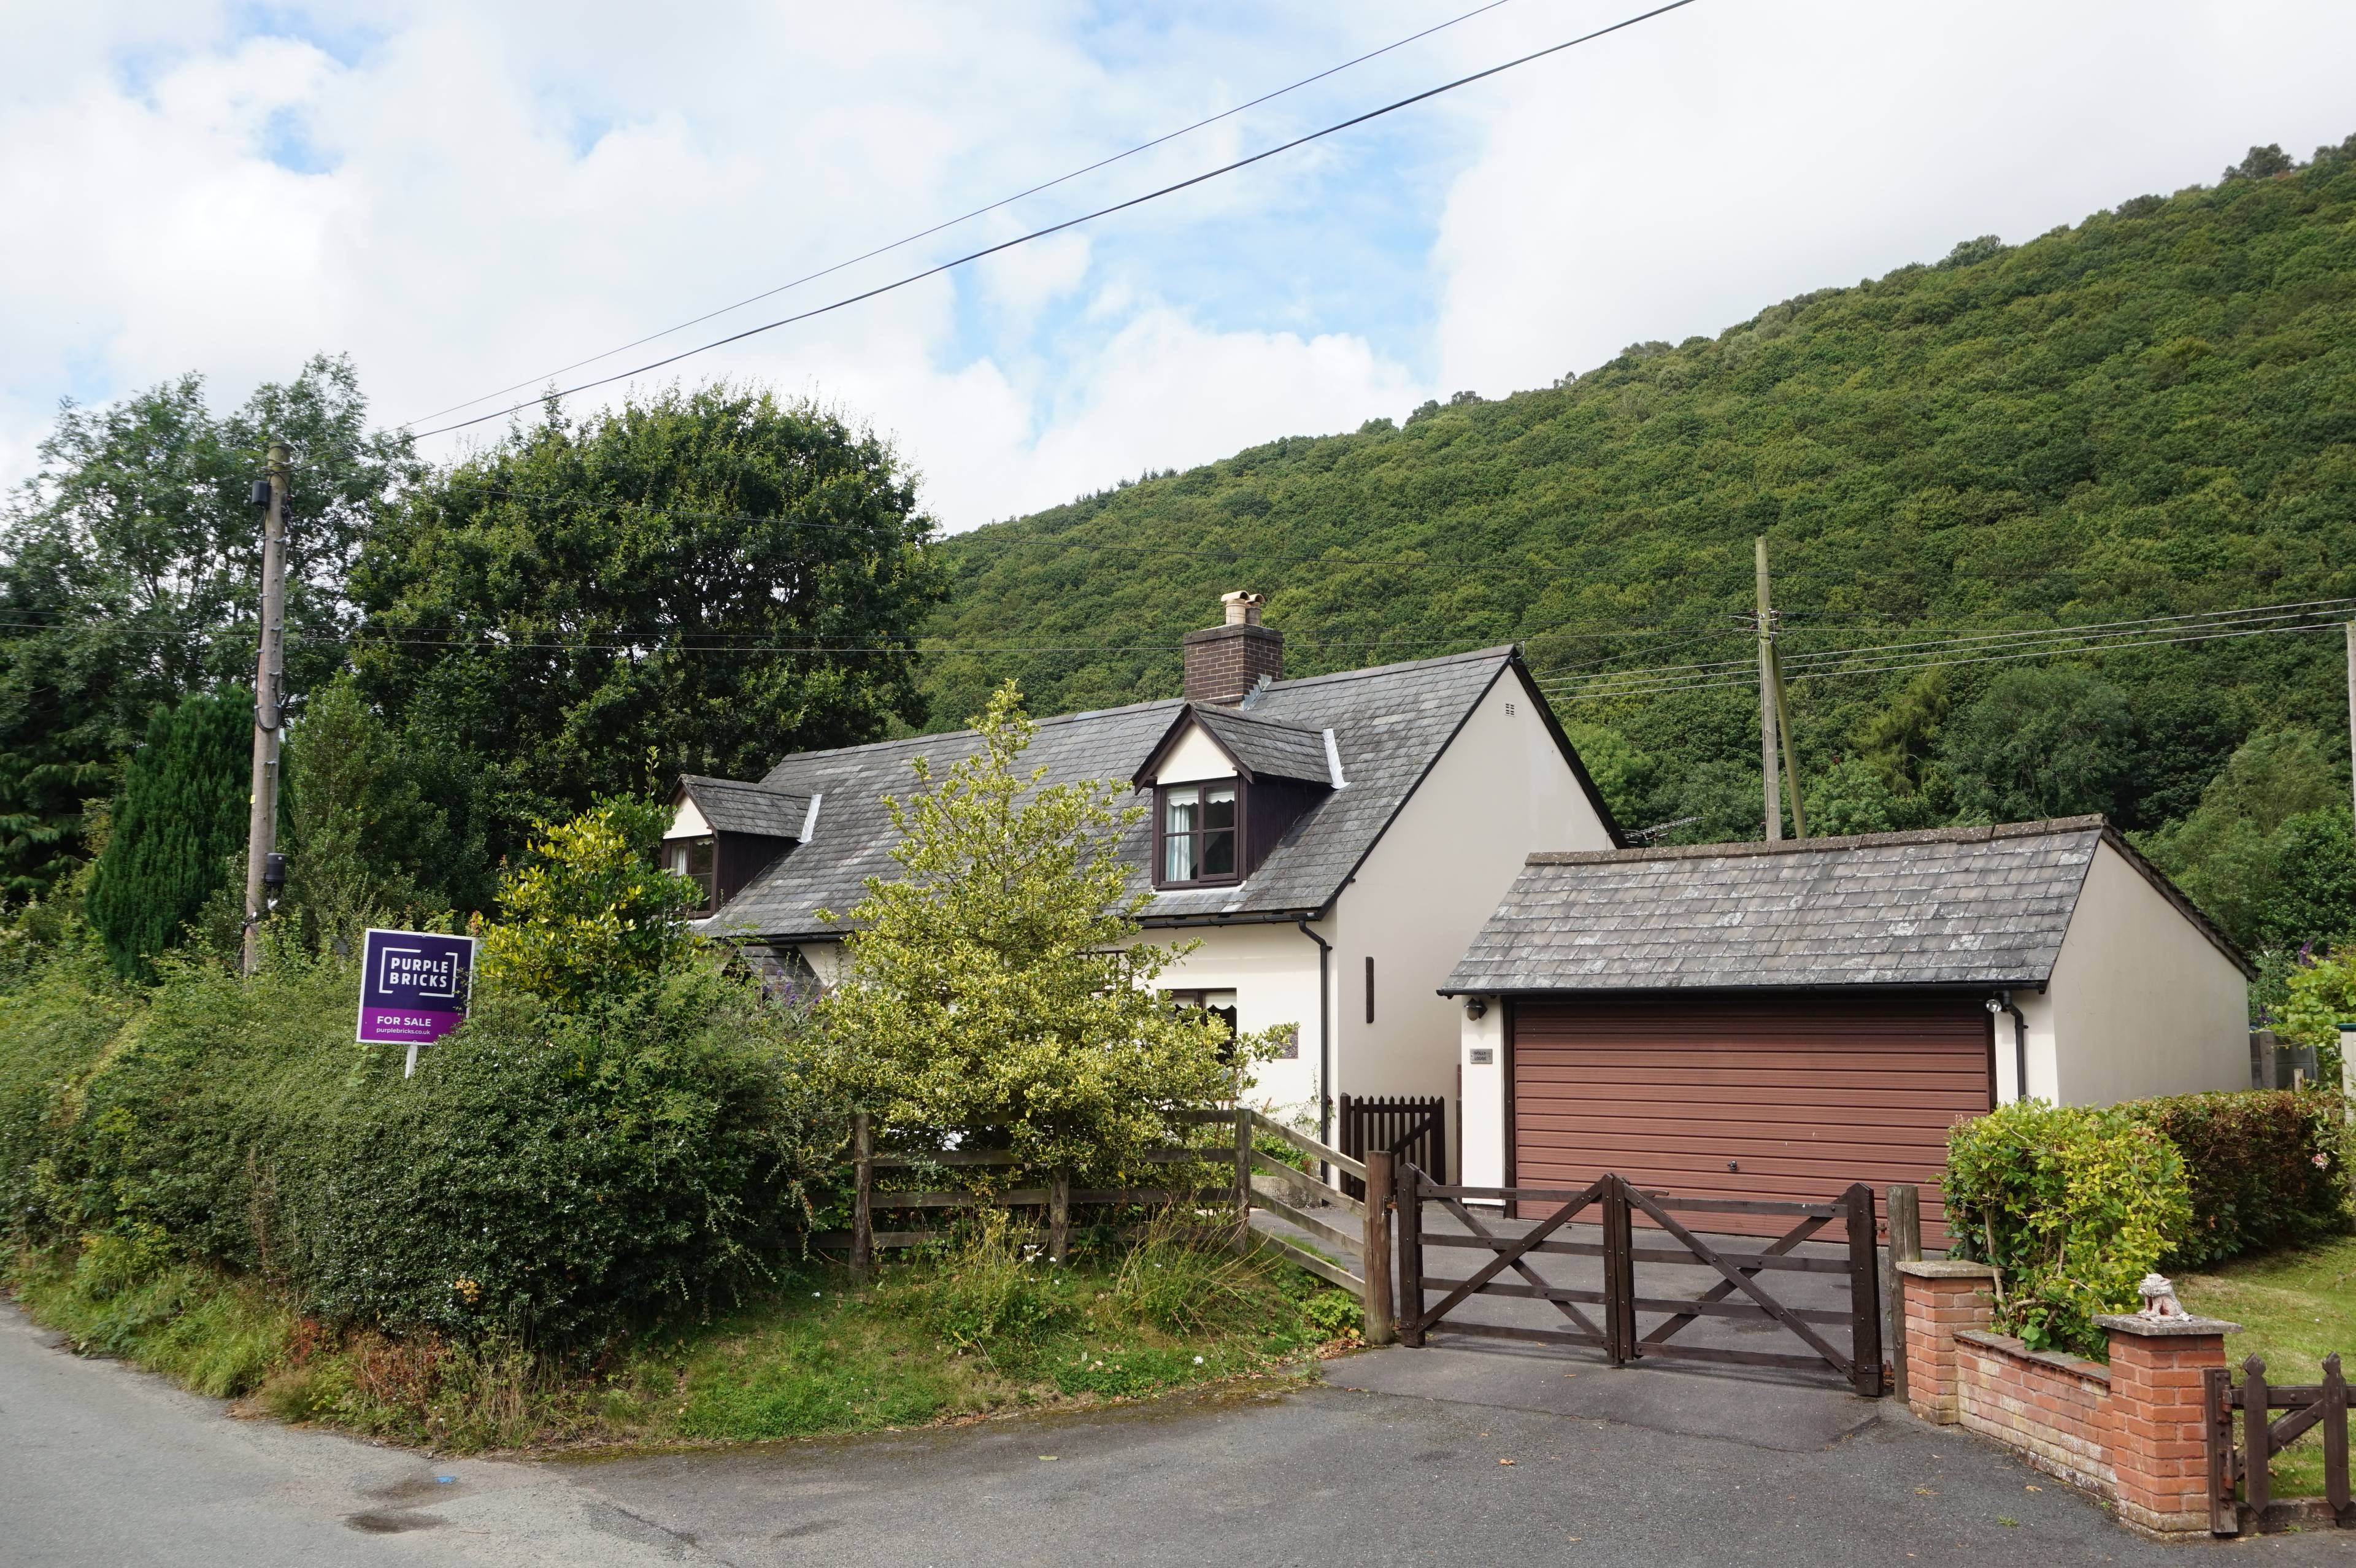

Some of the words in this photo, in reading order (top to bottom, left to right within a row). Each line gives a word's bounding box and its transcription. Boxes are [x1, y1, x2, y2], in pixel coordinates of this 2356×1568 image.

[391, 957, 448, 974] PURPLE
[390, 972, 447, 988] BRICKS
[377, 1016, 400, 1025] FOR
[404, 1017, 431, 1026] SALE
[376, 1027, 431, 1036] purplebricks.co.uk
